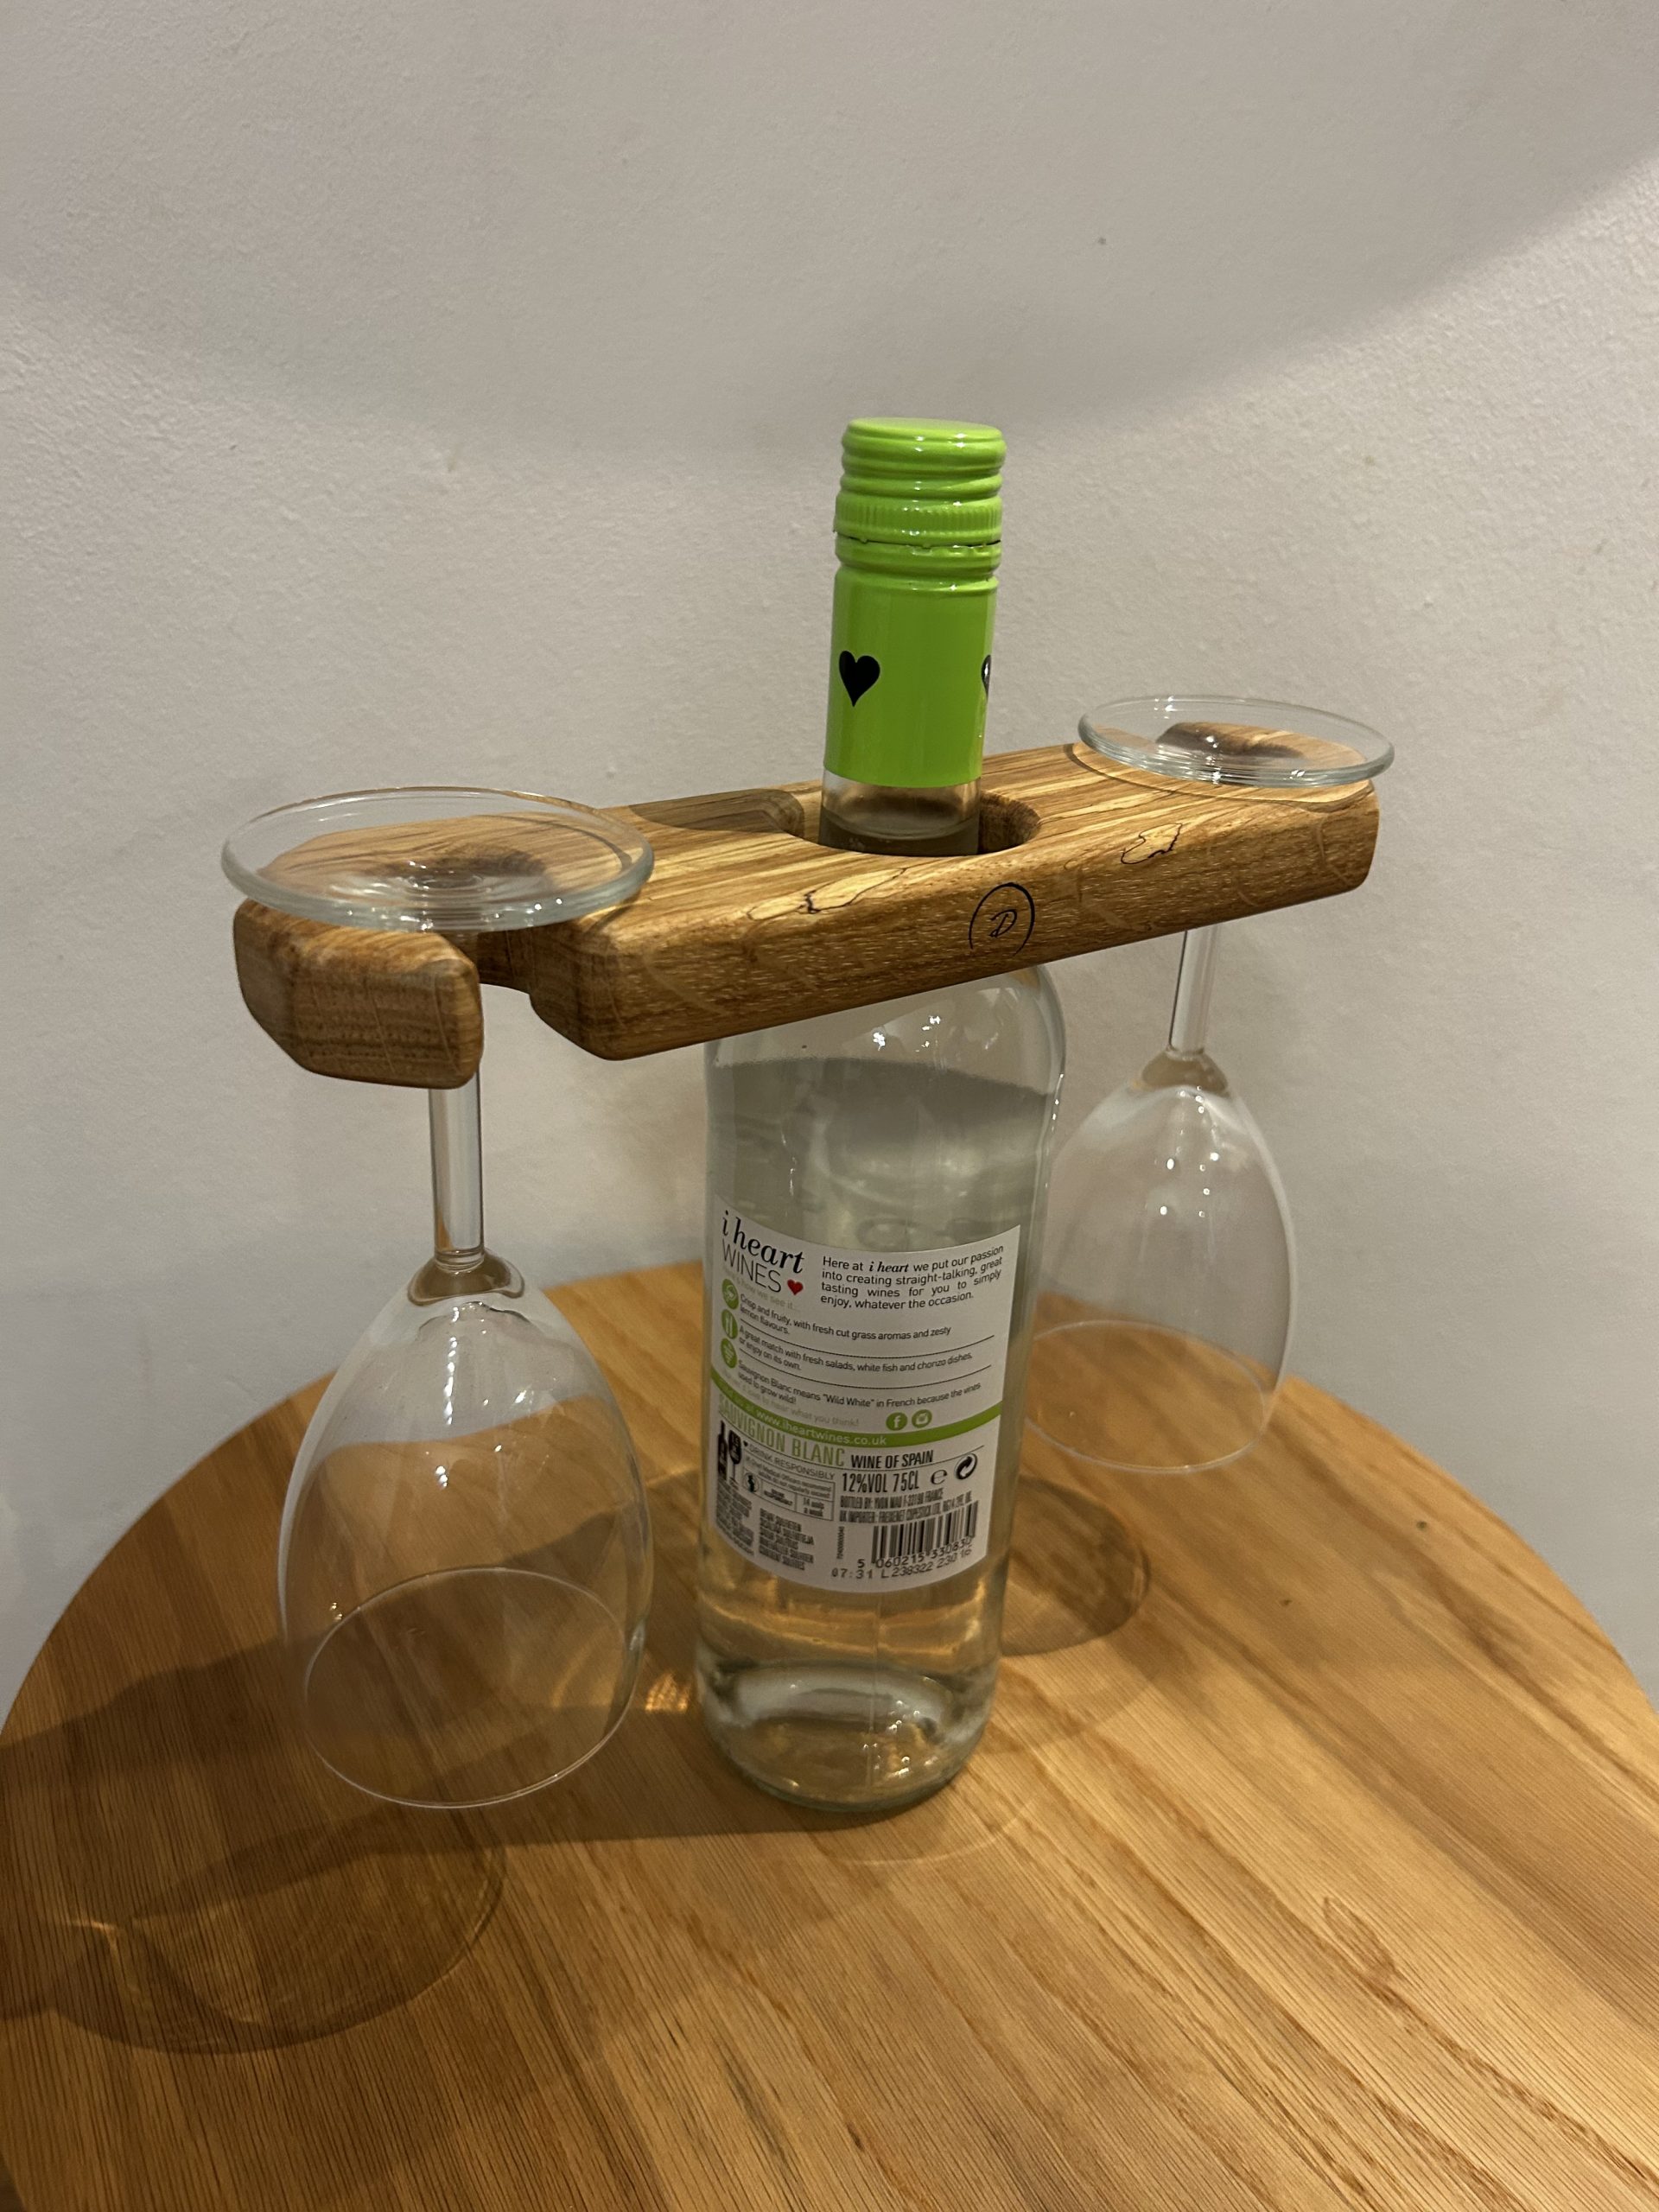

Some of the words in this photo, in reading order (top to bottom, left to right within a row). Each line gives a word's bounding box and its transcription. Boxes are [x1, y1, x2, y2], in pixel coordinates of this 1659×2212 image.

[722, 1210, 728, 1236] i
[733, 1216, 805, 1274] heart
[722, 1238, 782, 1293] WINES
[822, 1268, 842, 1281] into
[846, 1274, 892, 1287] creating
[980, 1256, 1003, 1273] great
[823, 1256, 849, 1269] Here
[852, 1262, 864, 1271] at
[869, 1261, 874, 1272] i
[877, 1261, 910, 1273] heart
[913, 1263, 929, 1272] we
[931, 1260, 949, 1272] put
[951, 1257, 969, 1267] our
[970, 1245, 1004, 1265] passion
[822, 1281, 858, 1298] tasting
[868, 1287, 900, 1297] wines
[909, 1287, 924, 1296] for
[931, 1285, 950, 1297] you
[974, 1268, 1001, 1286] simply
[855, 1299, 906, 1310] whatever
[908, 1300, 926, 1308] the
[928, 1291, 975, 1306] occasion.
[741, 1294, 756, 1310] Crisp
[758, 1304, 770, 1317] and
[794, 1320, 810, 1330] with
[813, 1323, 834, 1335] fresh
[836, 1329, 849, 1338] cut
[852, 1332, 876, 1340] grass
[912, 1329, 929, 1338] and
[931, 1326, 951, 1336] zesty
[745, 1330, 760, 1344] great
[761, 1338, 784, 1354] match
[785, 1349, 802, 1361] with
[803, 1353, 823, 1365] fresh
[825, 1359, 855, 1371] salads,
[882, 1363, 898, 1371] fish
[899, 1362, 916, 1371] and
[763, 1350, 772, 1360] on
[761, 1385, 777, 1397] grow
[771, 1377, 792, 1393] Blanc
[793, 1388, 821, 1401] means
[876, 1399, 885, 1408] in
[887, 1398, 915, 1408] French
[917, 1393, 950, 1405] because
[950, 1389, 963, 1398] the
[718, 1392, 785, 1452] SAUVIGNON
[791, 1438, 845, 1467] BLANC
[851, 1454, 882, 1468] WINE
[885, 1454, 899, 1468] OF
[902, 1450, 933, 1467] SPAIN
[774, 1456, 836, 1480] RESPONSIBLY
[893, 1471, 919, 1492] 75CL
[831, 1567, 873, 1580] 07:31
[857, 1559, 865, 1568] 5
[875, 1553, 924, 1568] 060215
